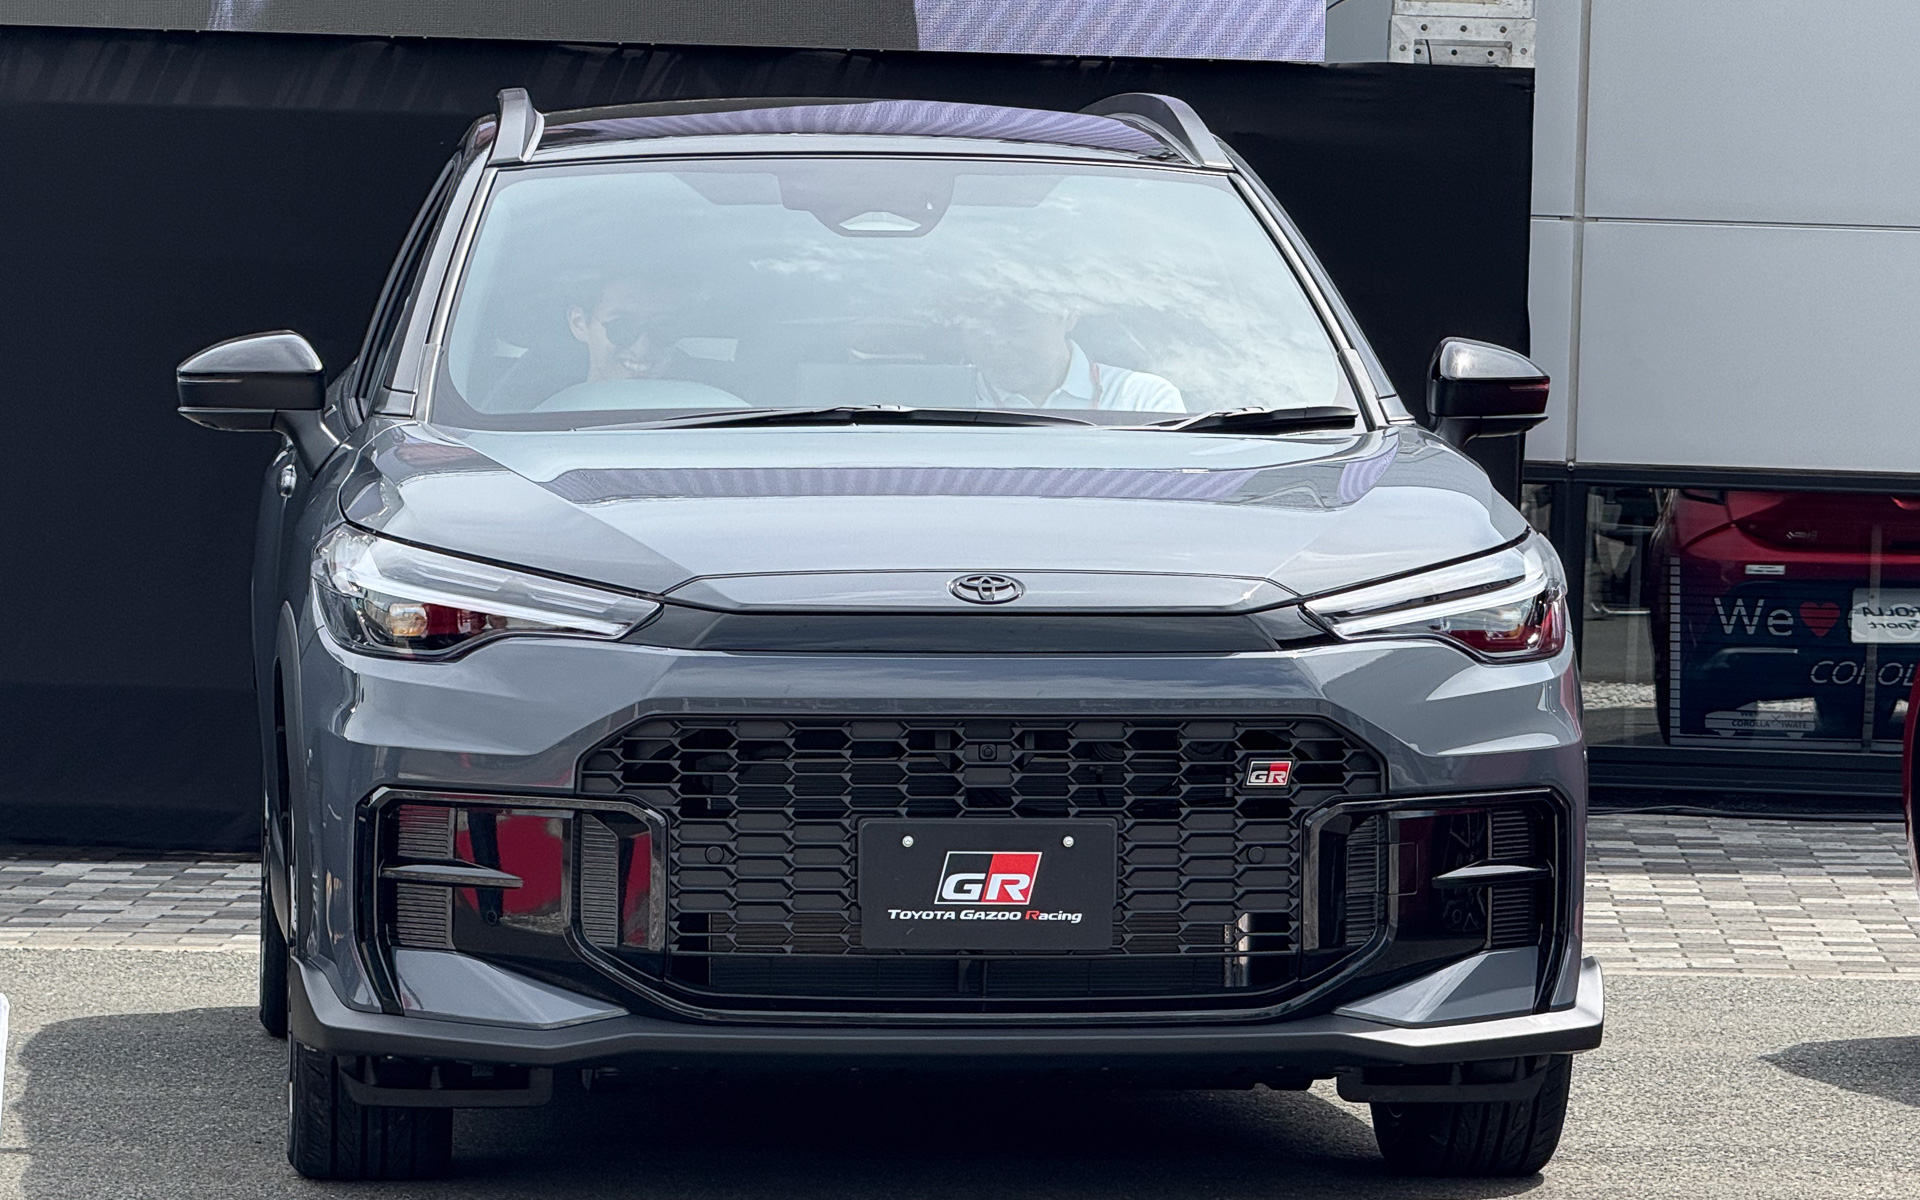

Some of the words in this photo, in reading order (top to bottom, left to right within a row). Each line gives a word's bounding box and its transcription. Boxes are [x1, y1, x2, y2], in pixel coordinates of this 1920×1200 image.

[1713, 598, 1794, 636] We
[1732, 720, 1770, 728] COROLLA
[1250, 770, 1287, 783] GR
[941, 873, 1031, 901] GR
[888, 909, 956, 921] TOYOTA
[960, 909, 1022, 921] GAZOO
[1025, 909, 1083, 923] Racing
